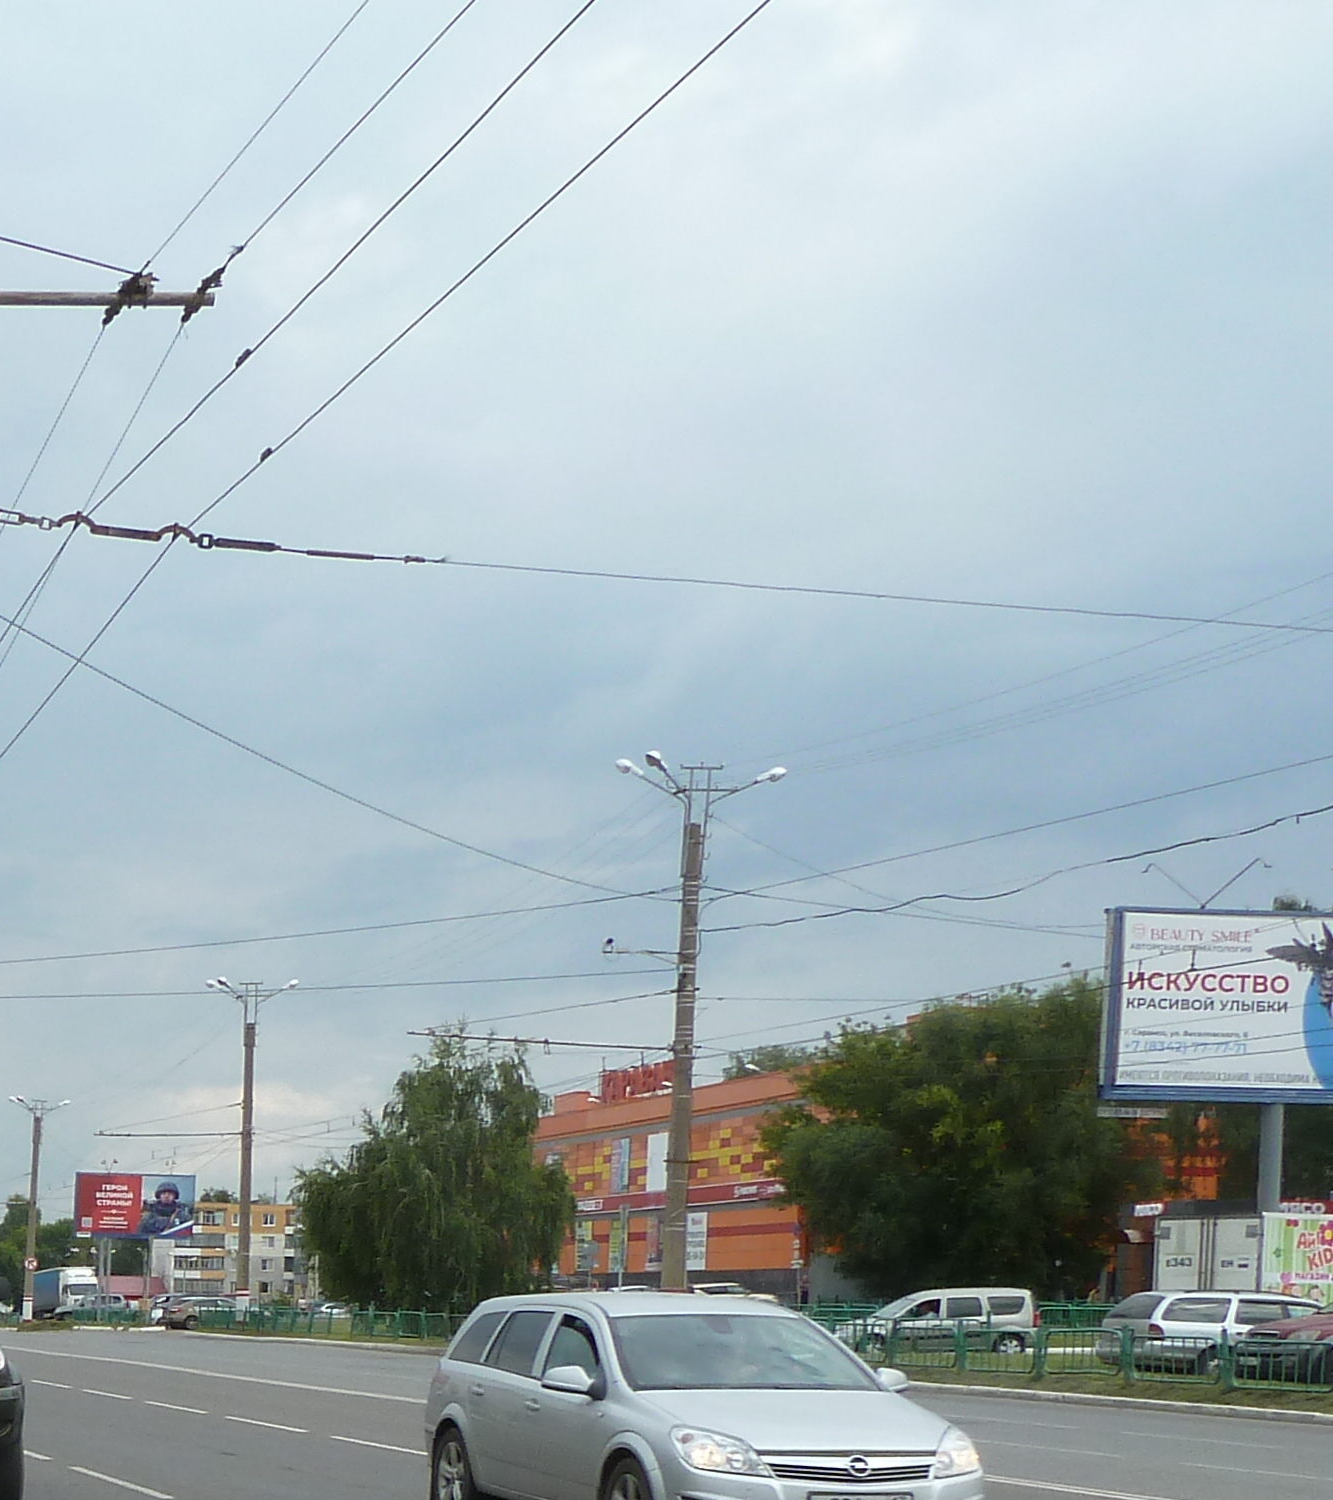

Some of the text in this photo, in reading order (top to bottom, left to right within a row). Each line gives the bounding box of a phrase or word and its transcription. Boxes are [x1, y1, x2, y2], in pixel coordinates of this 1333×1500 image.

[1150, 928, 1252, 943] BEAUTY SMILE
[1127, 971, 1290, 994] ИСКУССТВО
[1126, 997, 1288, 1013] КРАСИВОЙ УЛЫБКИ
